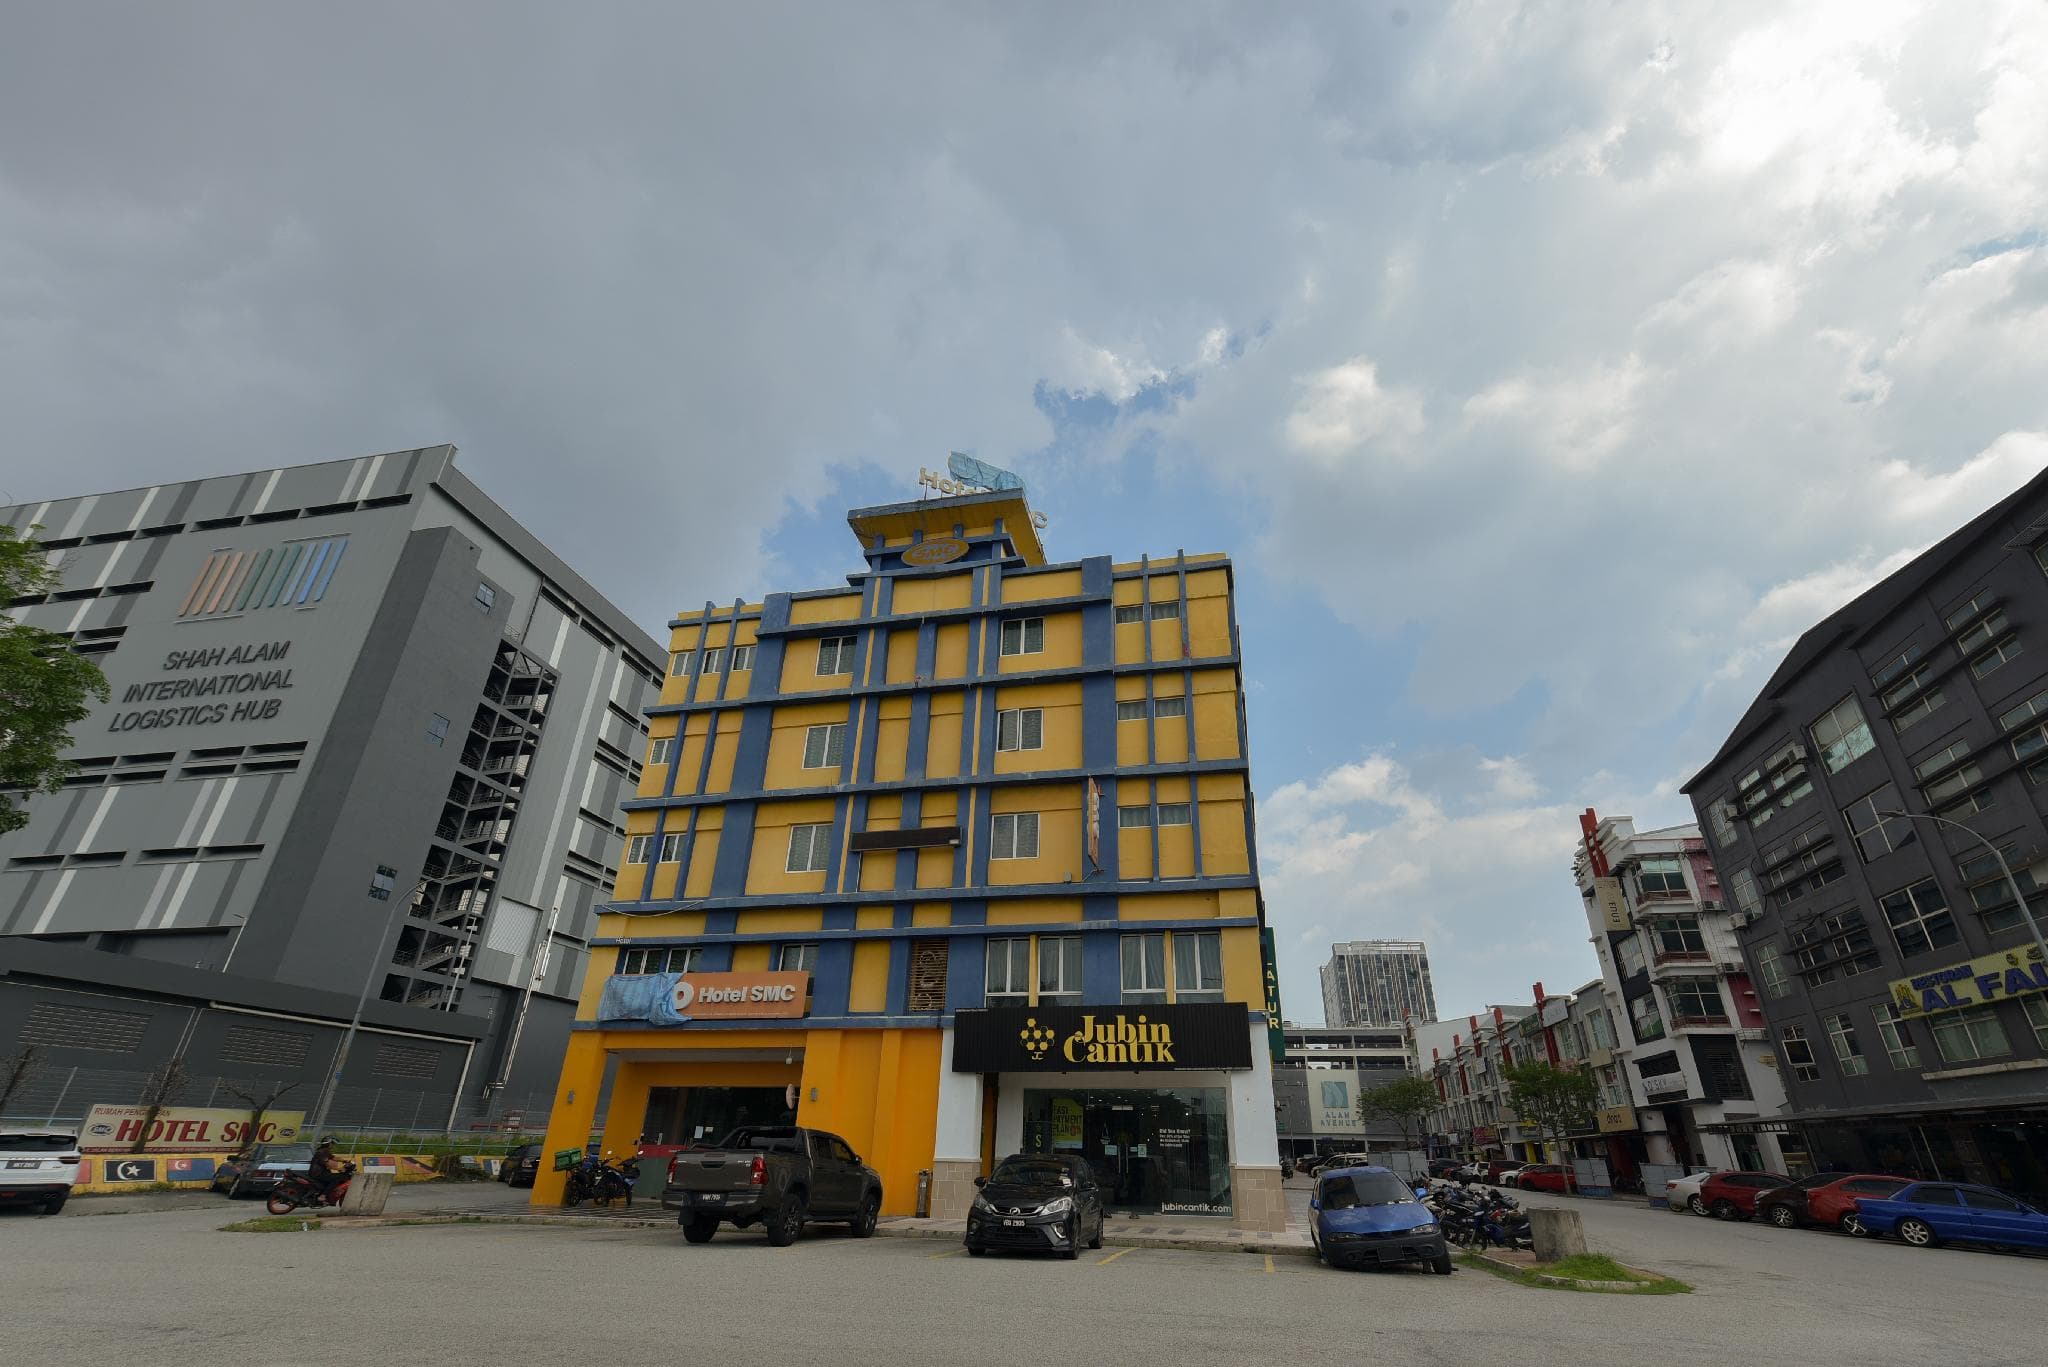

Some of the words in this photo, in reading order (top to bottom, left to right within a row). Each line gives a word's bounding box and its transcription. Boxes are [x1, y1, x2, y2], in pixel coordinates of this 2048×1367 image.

[163, 647, 225, 671] SHAH
[224, 640, 291, 664] ALAM
[122, 669, 293, 703] INTERNATIONAL
[108, 703, 228, 732] LOGISTICS
[230, 698, 282, 722] HUB
[1911, 965, 1974, 990] RESTORAN
[698, 986, 748, 1003] Hotel
[750, 984, 796, 1002] SMC
[1266, 962, 1280, 1030] ATUR
[1922, 985, 1972, 1013] AL
[1082, 1015, 1172, 1043] Jubin
[1063, 1034, 1177, 1063] Cantik
[95, 1107, 122, 1116] RUMAH
[1320, 1119, 1357, 1127] AVENUE
[1325, 1111, 1350, 1119] ALAM
[1161, 1201, 1232, 1213] jubincantik.com
